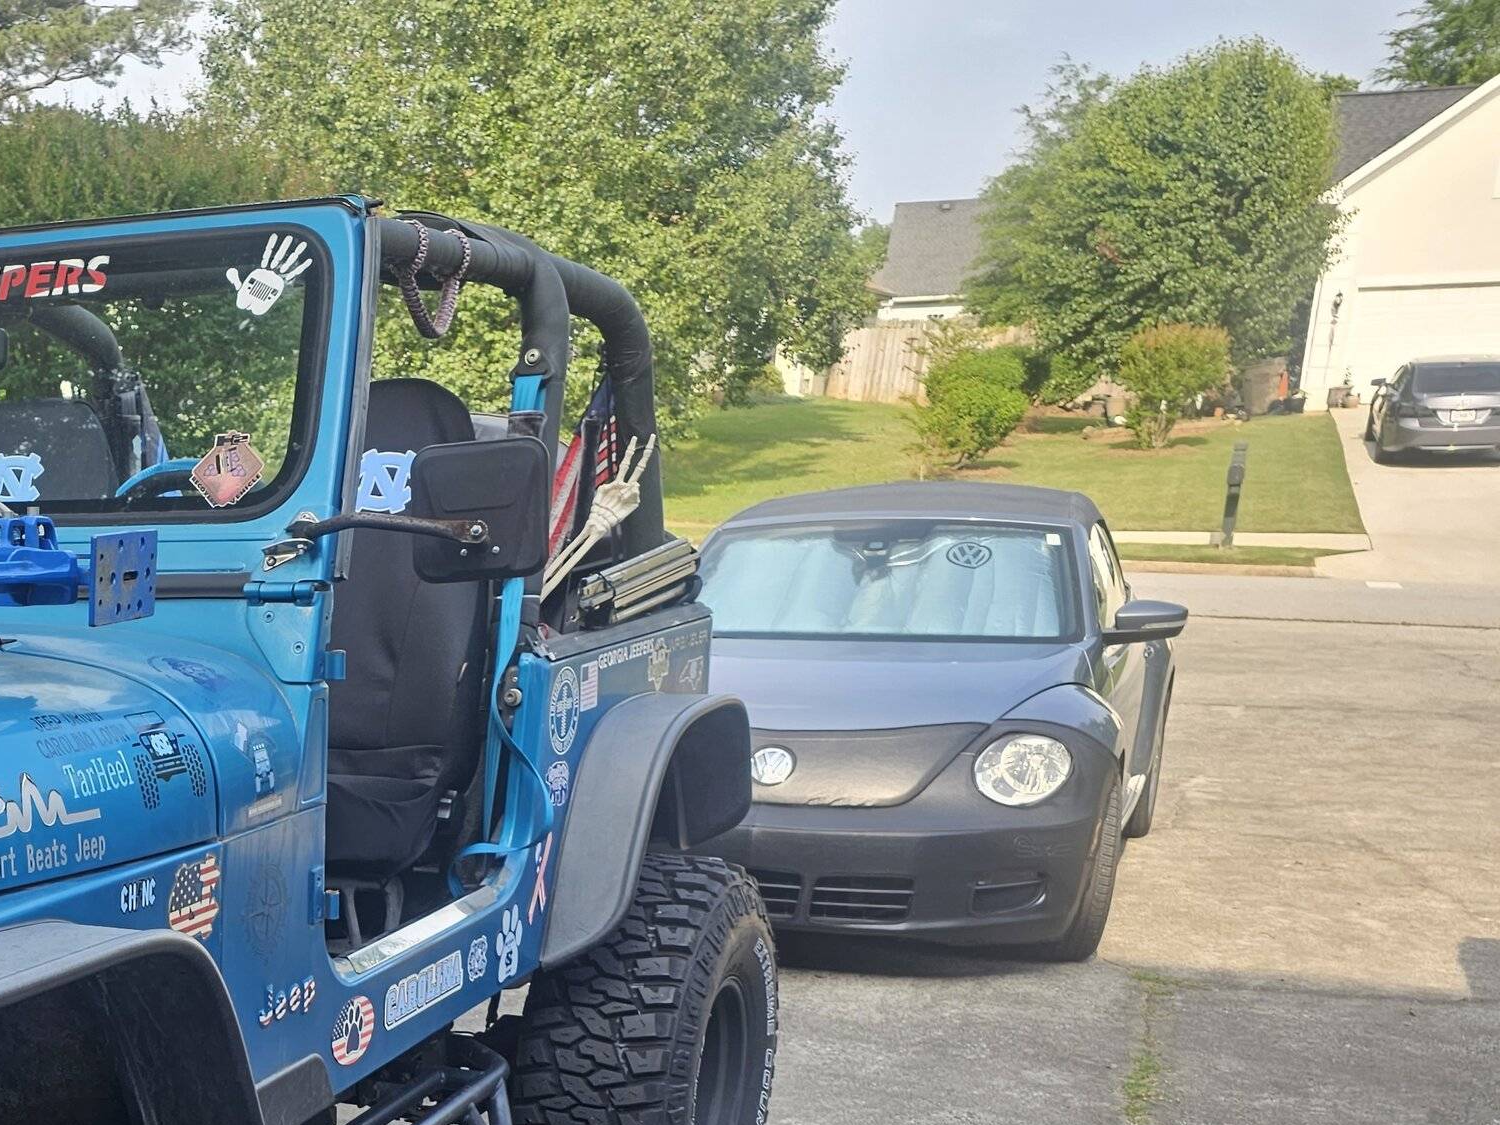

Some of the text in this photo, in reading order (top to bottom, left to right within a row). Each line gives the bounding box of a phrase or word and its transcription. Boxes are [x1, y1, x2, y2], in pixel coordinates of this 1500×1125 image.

[598, 648, 629, 669] GEORGIA
[629, 638, 655, 660] JEEPERS
[62, 750, 135, 799] TarHeel
[26, 840, 67, 874] Beats
[75, 833, 106, 862] Jeep
[385, 952, 463, 1029] CAROLINA
[754, 937, 775, 1036] EXTREME
